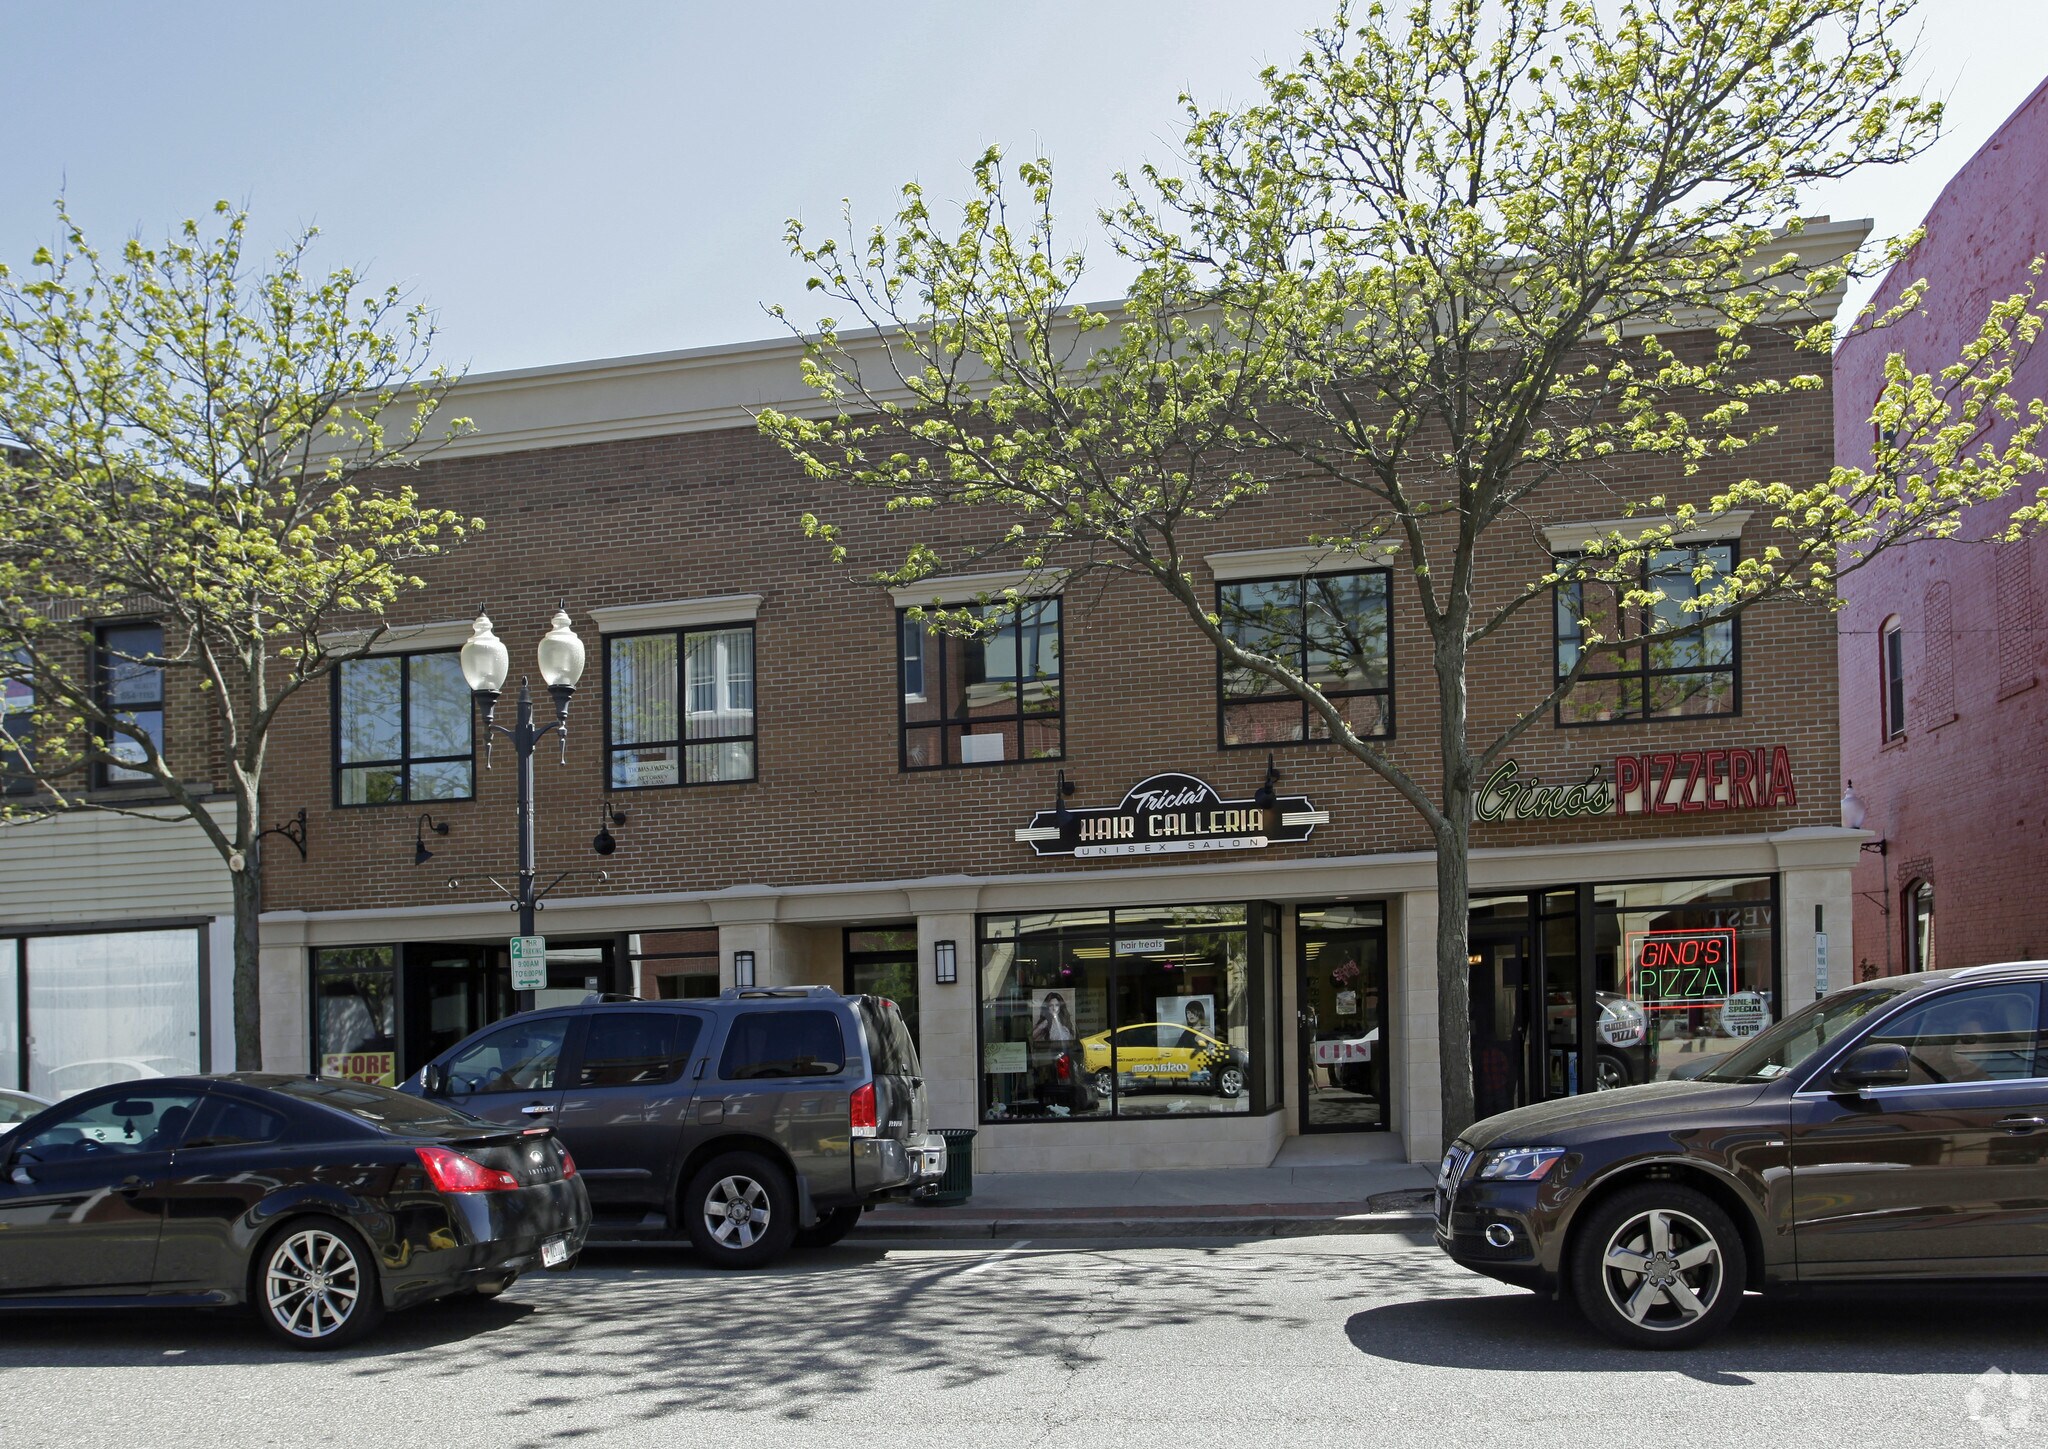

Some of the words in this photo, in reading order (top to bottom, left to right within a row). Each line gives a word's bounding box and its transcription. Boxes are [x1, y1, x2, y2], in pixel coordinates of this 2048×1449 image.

[1476, 759, 1614, 823] Gino's
[1615, 746, 1797, 817] PIZZERIA
[1131, 785, 1207, 813] Tricia's
[1079, 815, 1134, 841] HAIR
[1149, 808, 1264, 837] GALLERIA
[1081, 843, 1166, 855] UNISEX
[1188, 839, 1259, 850] SALON
[512, 941, 521, 955] 2
[1121, 941, 1136, 949] hair
[1139, 940, 1162, 948] treats
[1640, 939, 1722, 967] GINO'S
[1639, 967, 1723, 998] PIZZA
[1729, 998, 1760, 1006] DINE-IN
[326, 1055, 390, 1075] STORE
